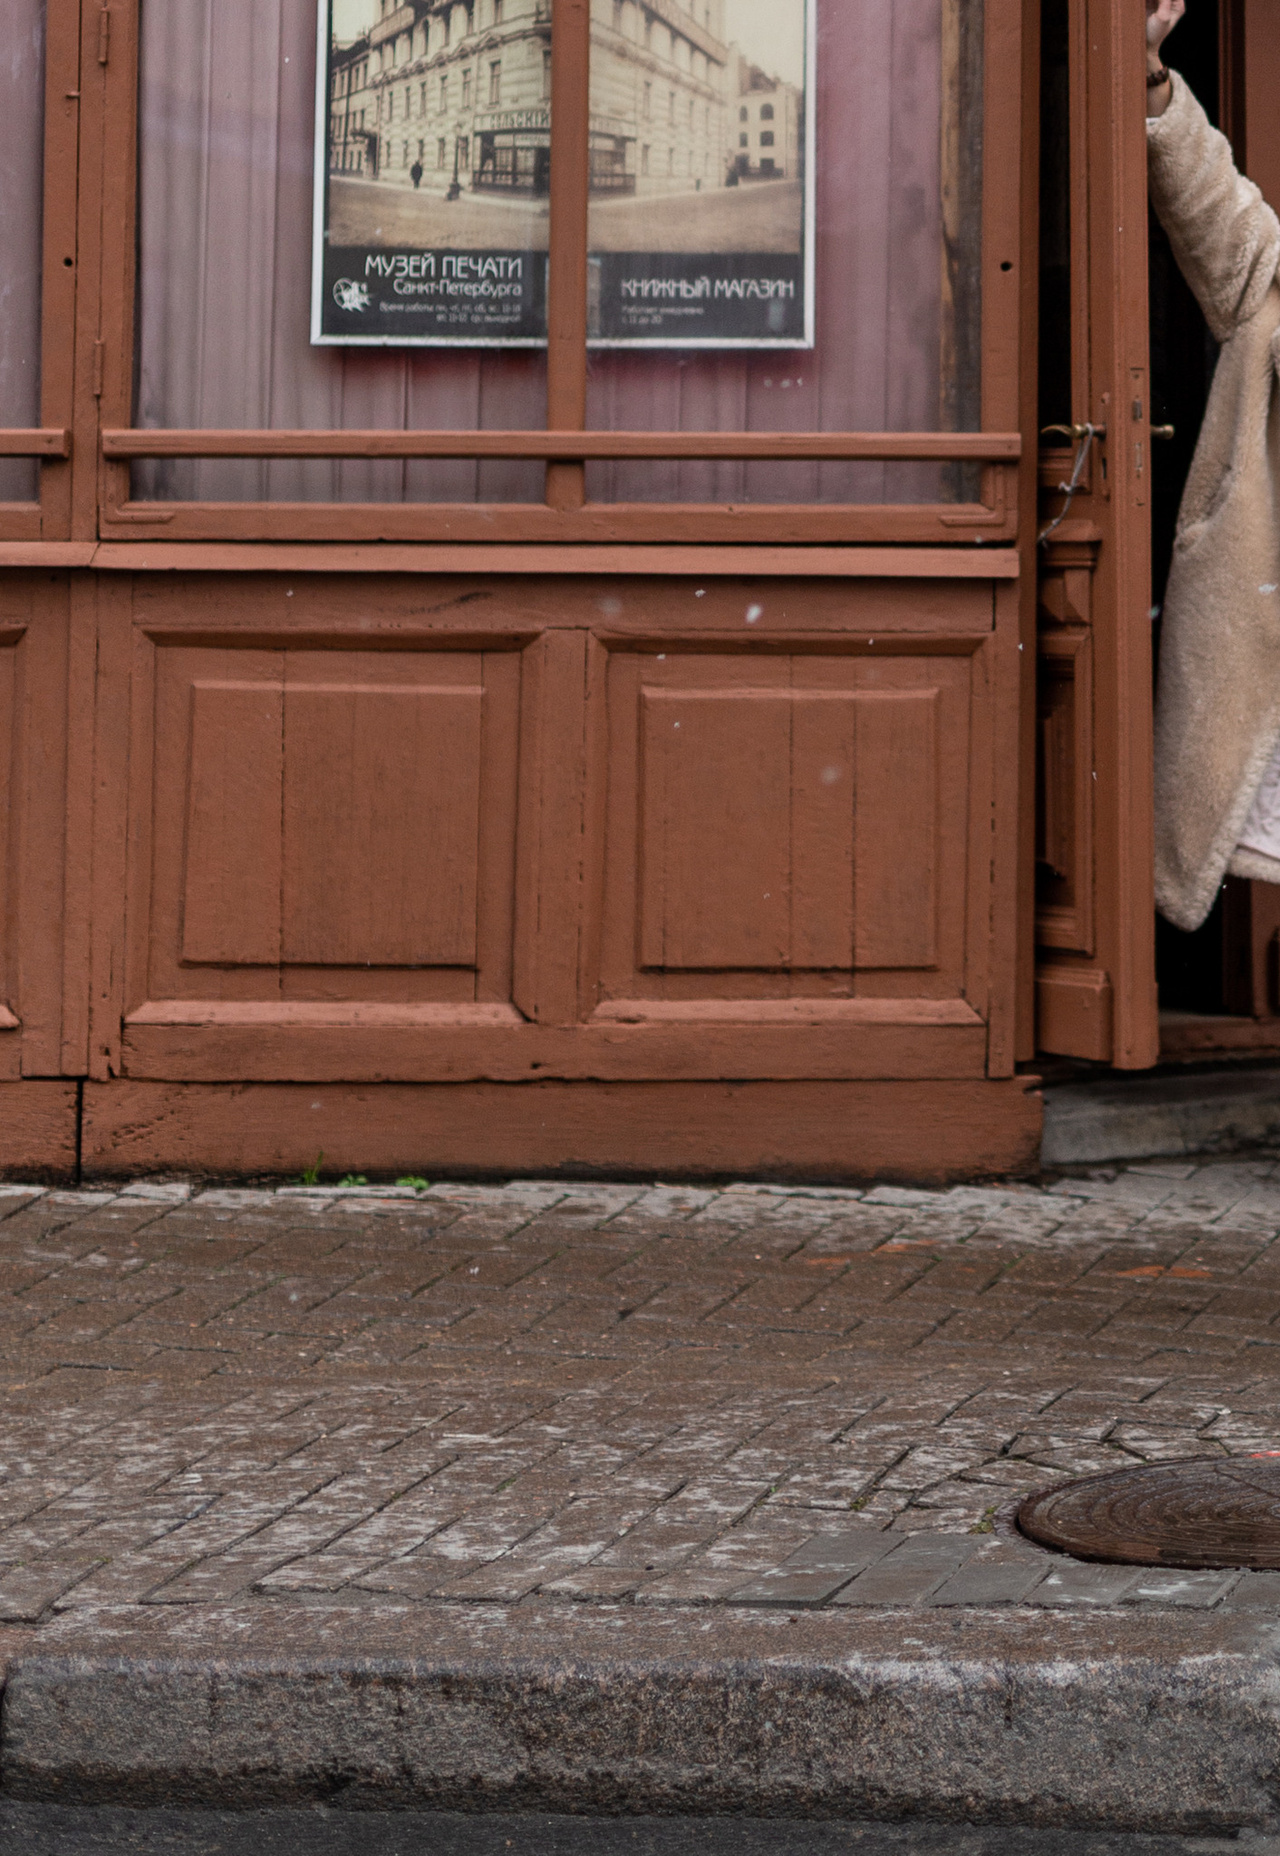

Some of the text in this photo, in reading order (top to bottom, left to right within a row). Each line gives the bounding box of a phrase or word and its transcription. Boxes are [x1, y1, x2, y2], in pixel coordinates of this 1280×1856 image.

[364, 253, 522, 279] МУЗЕЙ ПЕЧАТИ
[392, 277, 522, 299] Санкт-Петербурга
[621, 275, 795, 300] КНИЖНЫЙ МАГАЗИН
